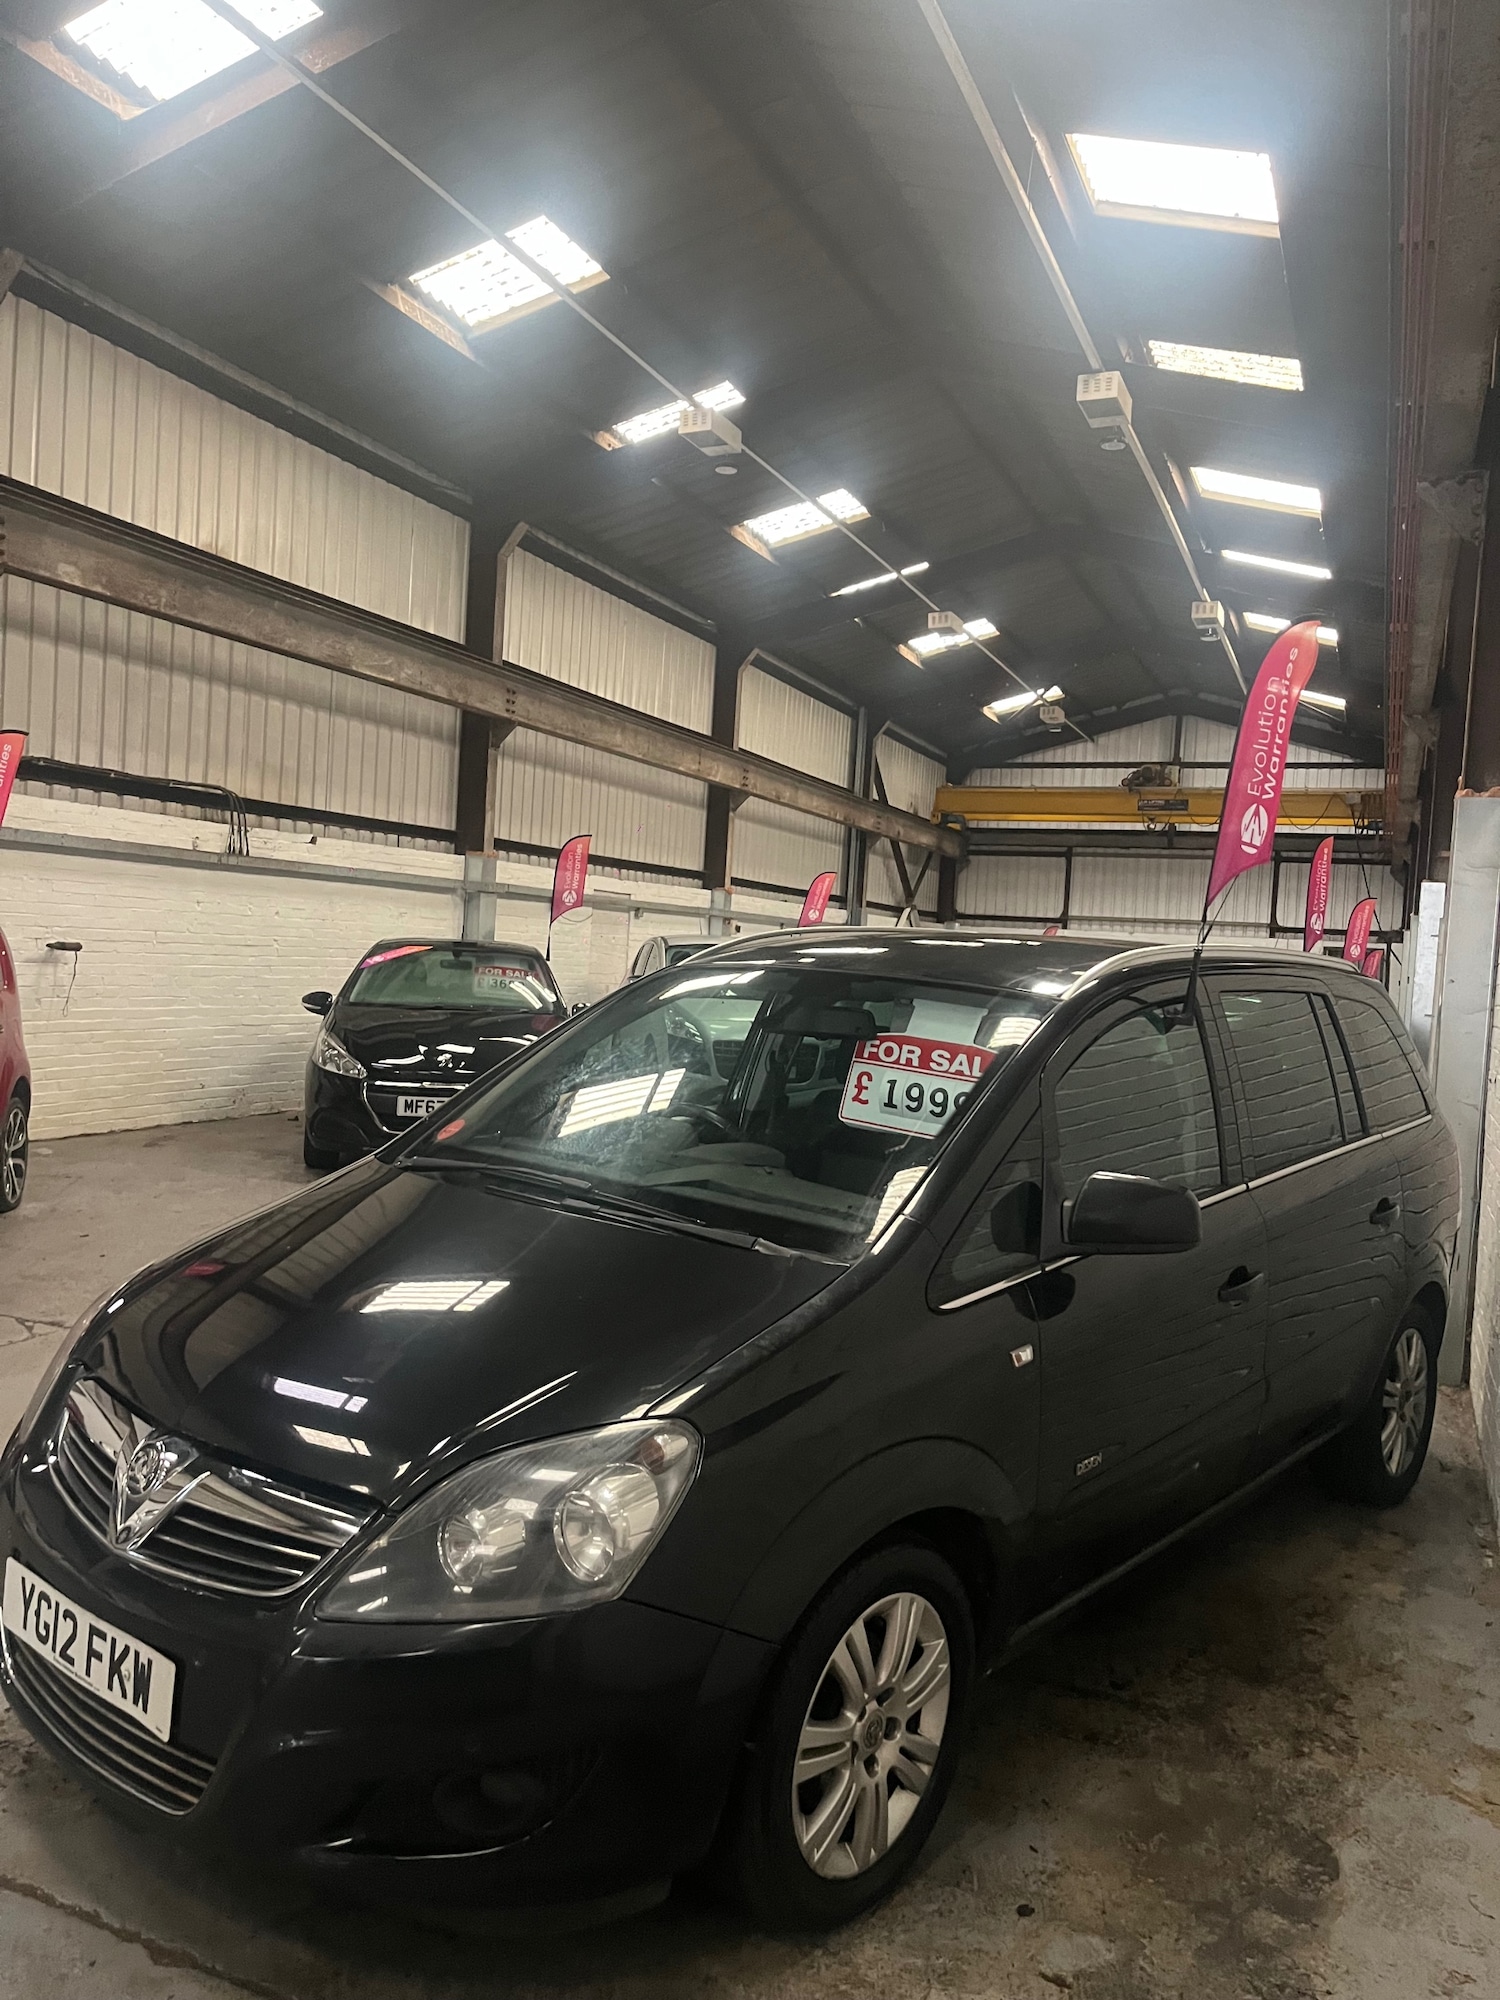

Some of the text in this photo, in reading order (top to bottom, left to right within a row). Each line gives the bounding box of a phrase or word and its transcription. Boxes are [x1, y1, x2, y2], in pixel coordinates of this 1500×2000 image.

[1247, 677, 1280, 796] Evolution
[1262, 647, 1299, 799] Warranties
[571, 843, 583, 889] Warranties
[1319, 847, 1329, 911] Warranties
[478, 967, 502, 976] FOR
[863, 1040, 922, 1067] FOR
[851, 1071, 873, 1105] £
[21, 1576, 153, 1715] YG12 FKW
